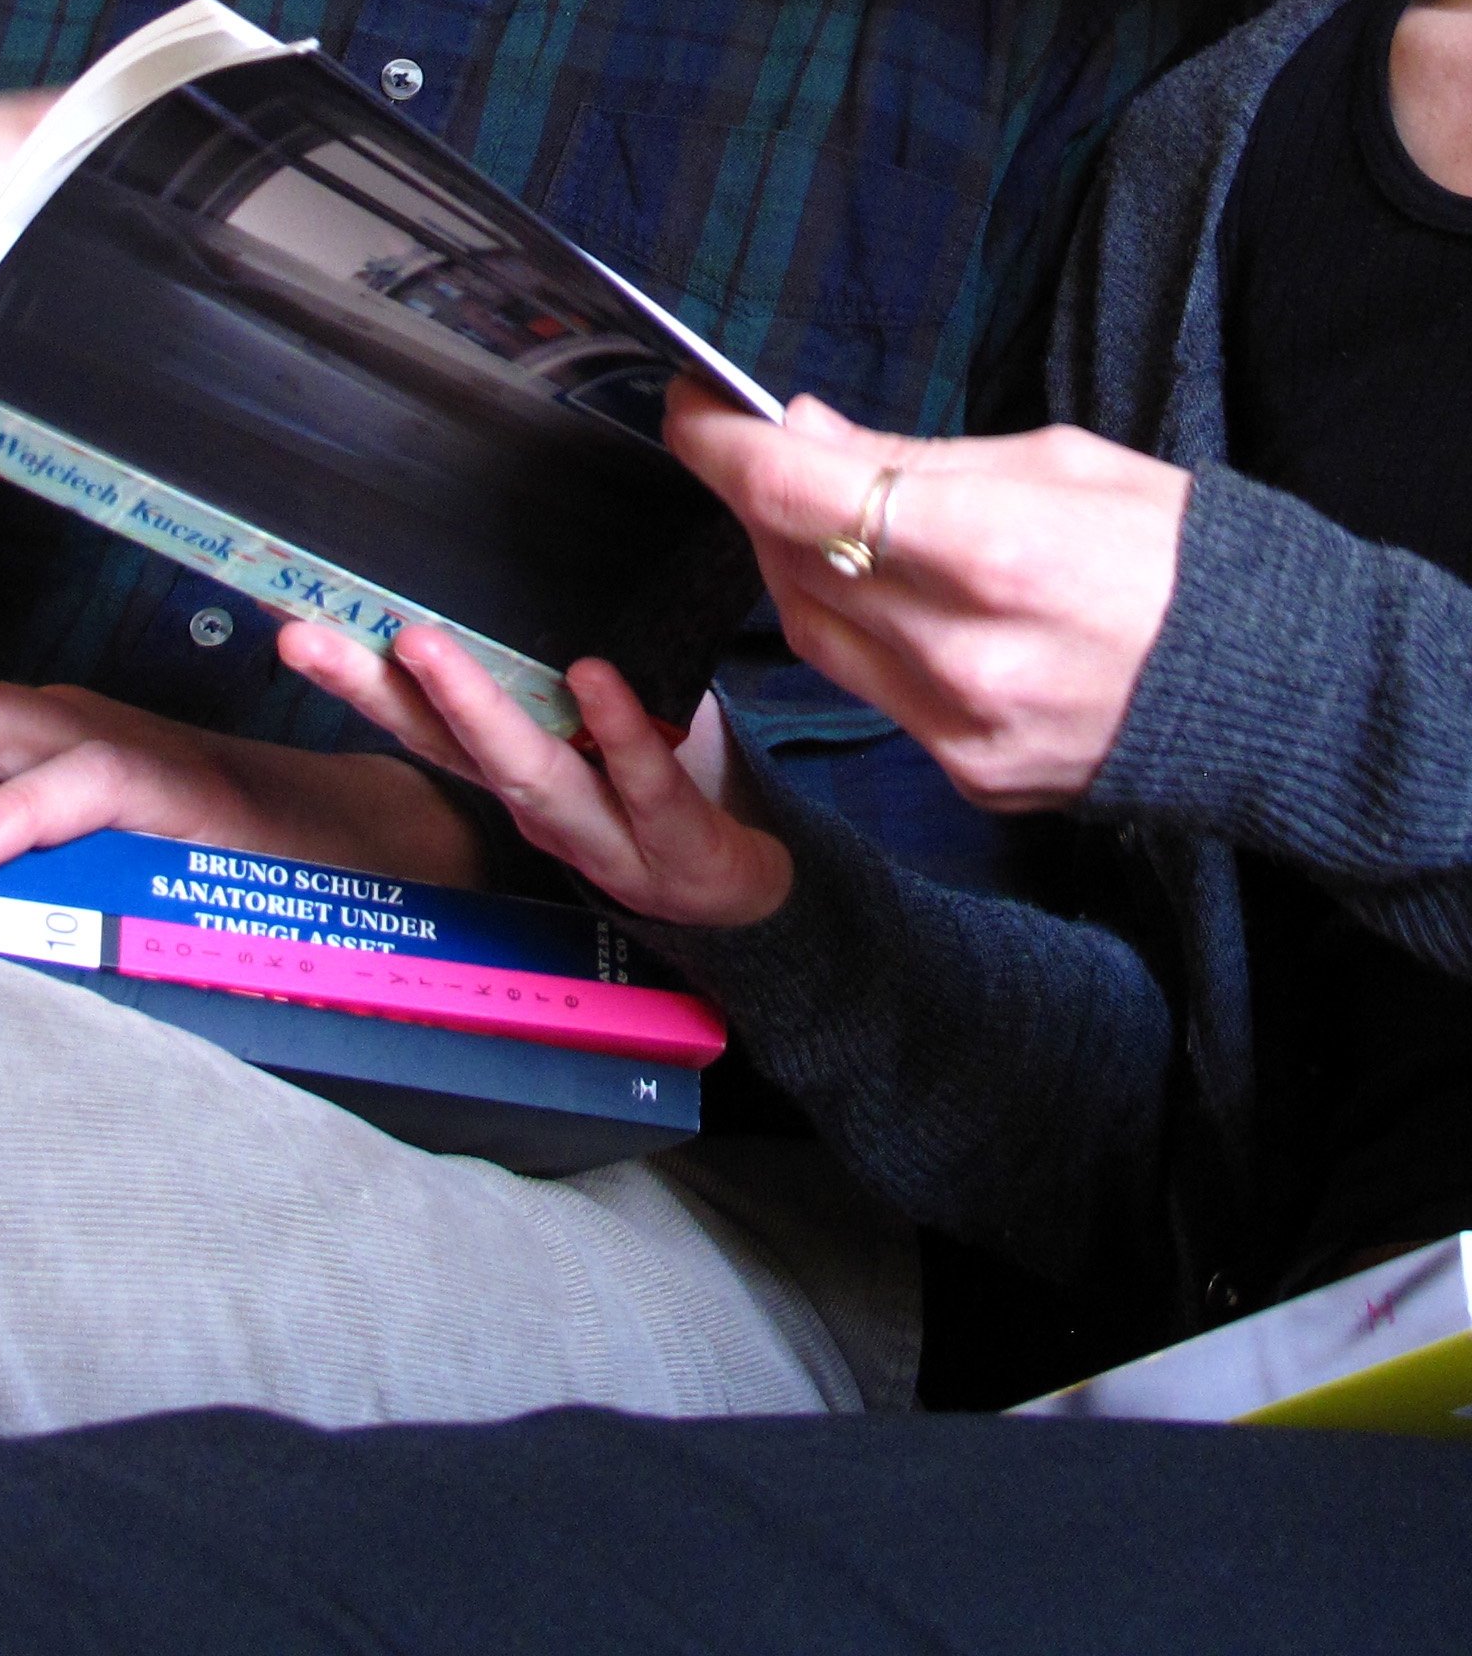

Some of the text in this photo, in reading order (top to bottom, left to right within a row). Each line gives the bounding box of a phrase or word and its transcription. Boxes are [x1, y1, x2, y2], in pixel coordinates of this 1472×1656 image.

[130, 498, 235, 561] Kuczok
[270, 566, 404, 641] SKAR
[151, 874, 437, 941] SANATORIET UNDER
[189, 849, 403, 906] BRUNO SCHULZ
[45, 911, 79, 951] 10
[597, 920, 611, 984] ATZER
[355, 970, 579, 1010] lyrikere
